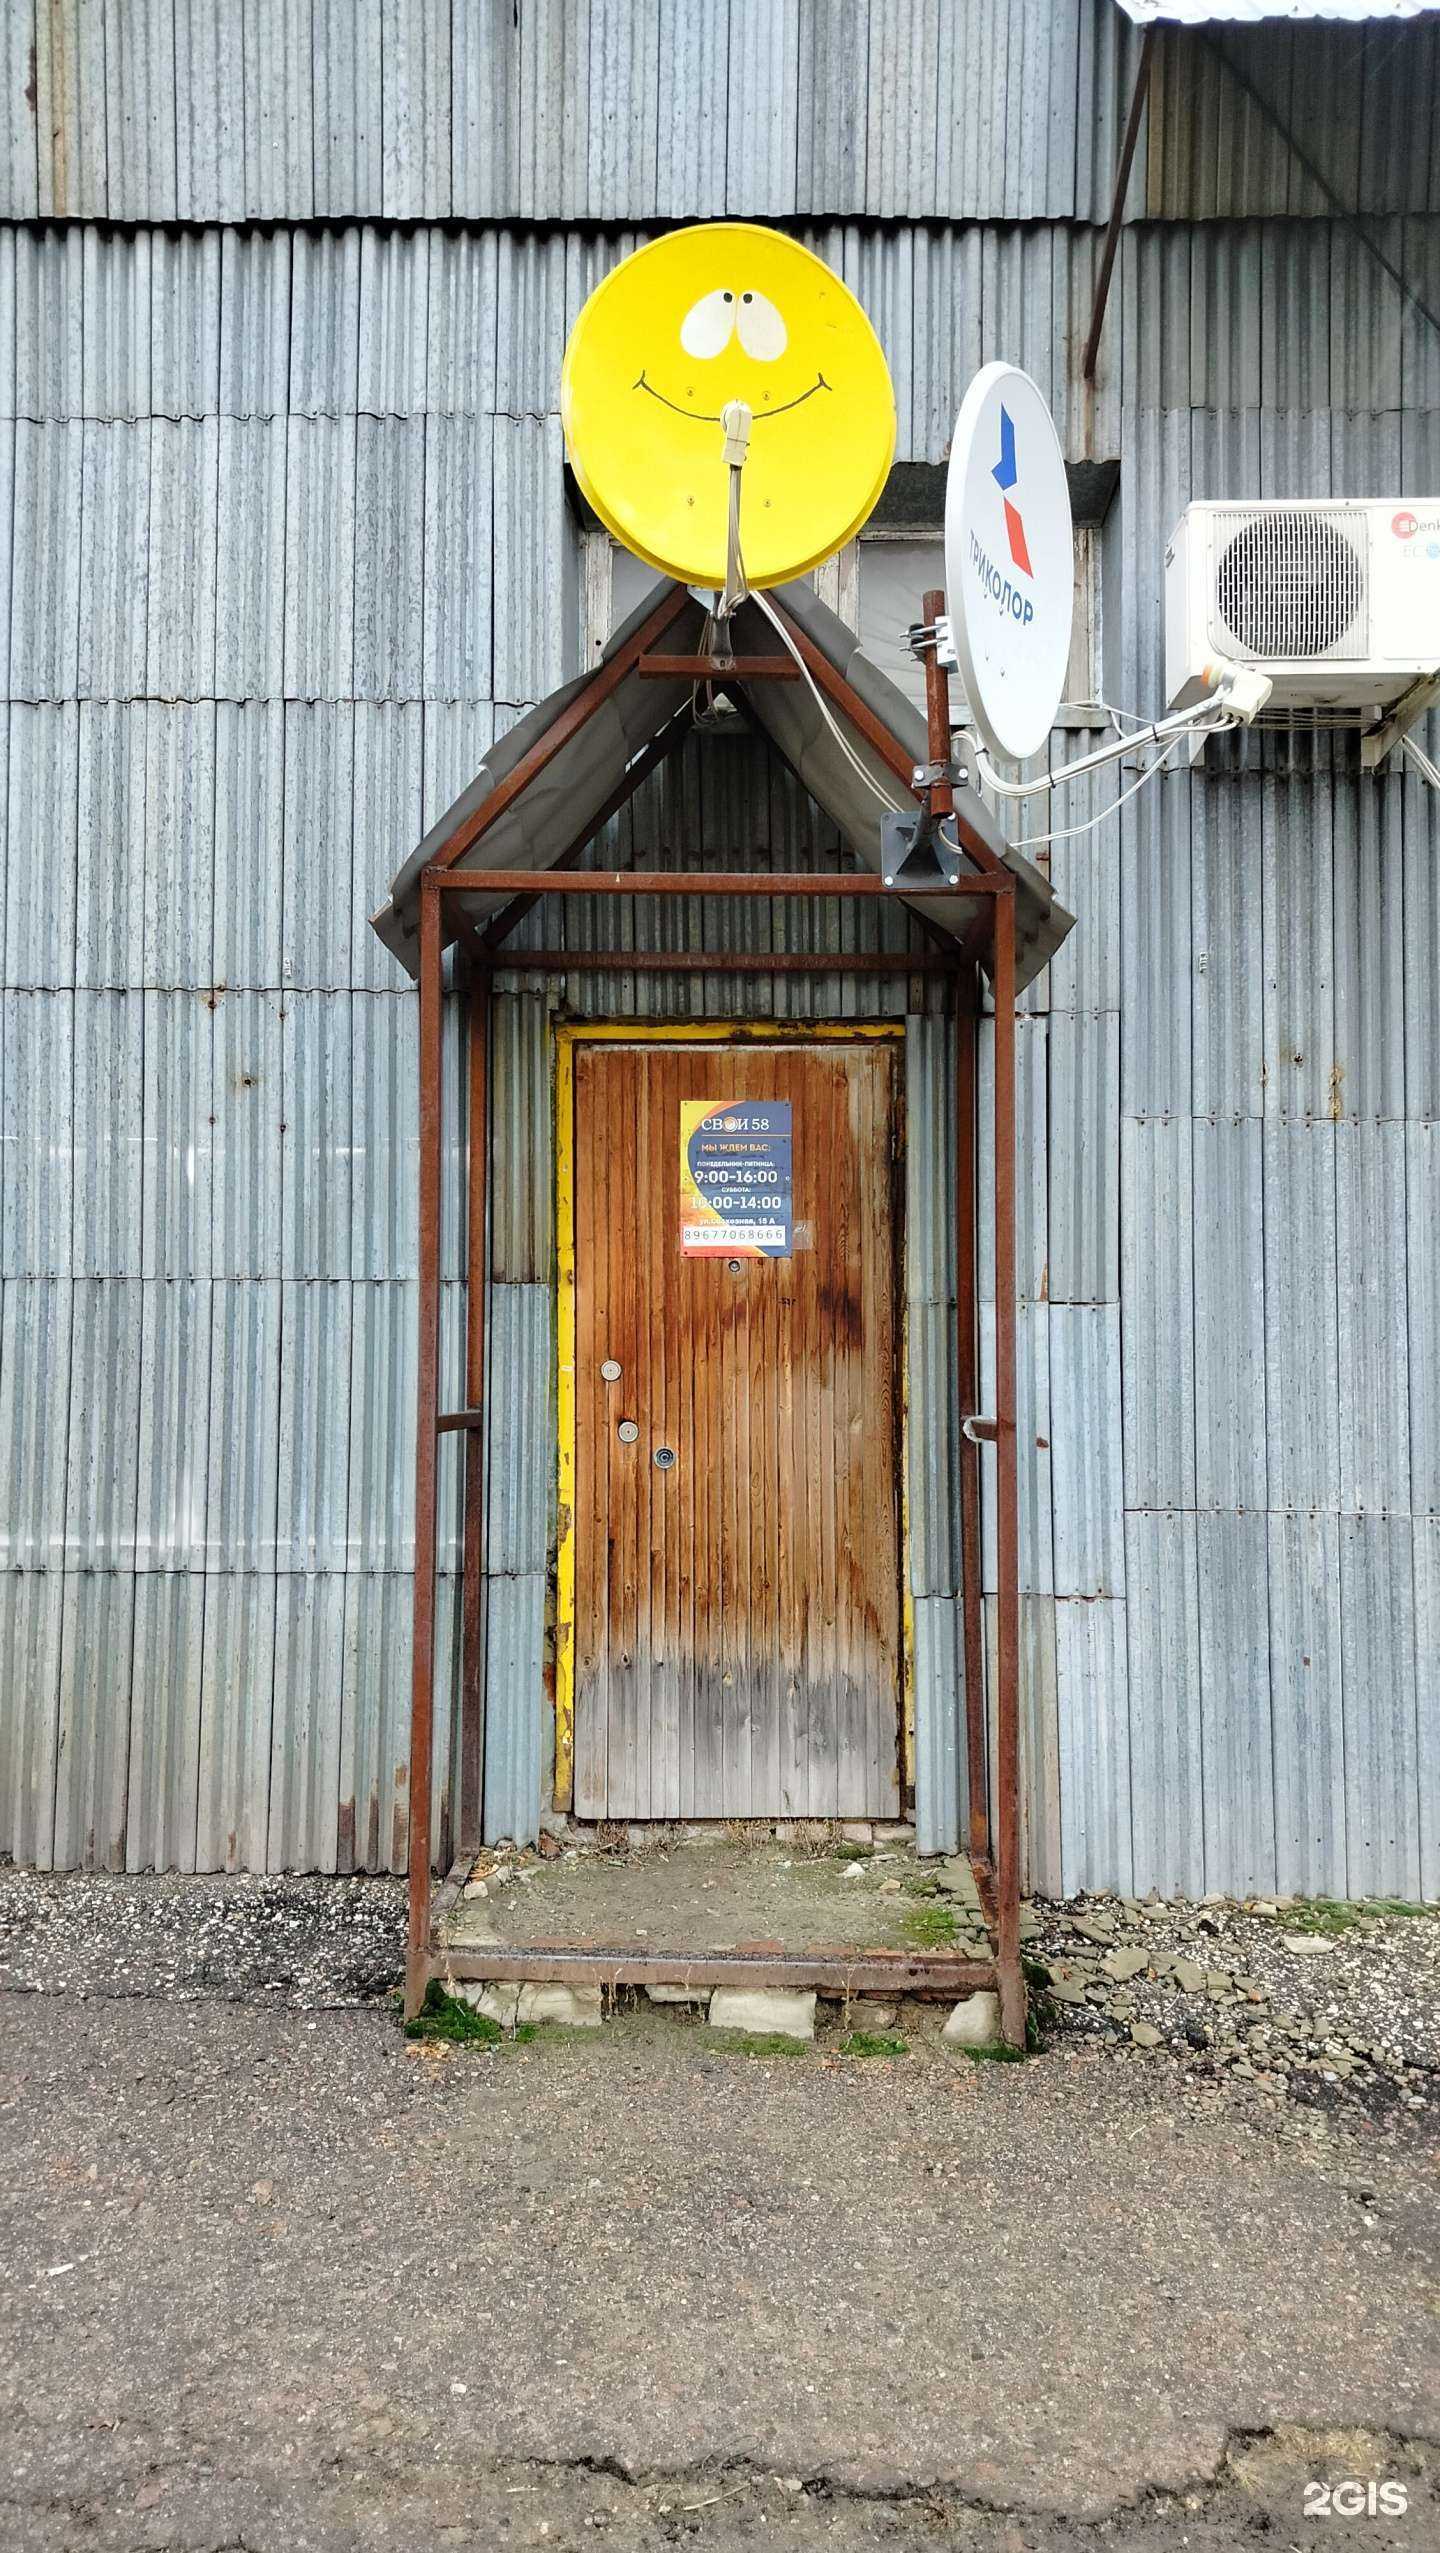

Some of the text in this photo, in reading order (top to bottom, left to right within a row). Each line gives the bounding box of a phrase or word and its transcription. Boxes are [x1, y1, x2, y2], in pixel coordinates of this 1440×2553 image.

[969, 528, 1034, 626] ТРИКОЛОР
[751, 1118, 769, 1131] 58
[701, 1144, 717, 1152] МЫ
[684, 1230, 783, 1240] 89677068666
